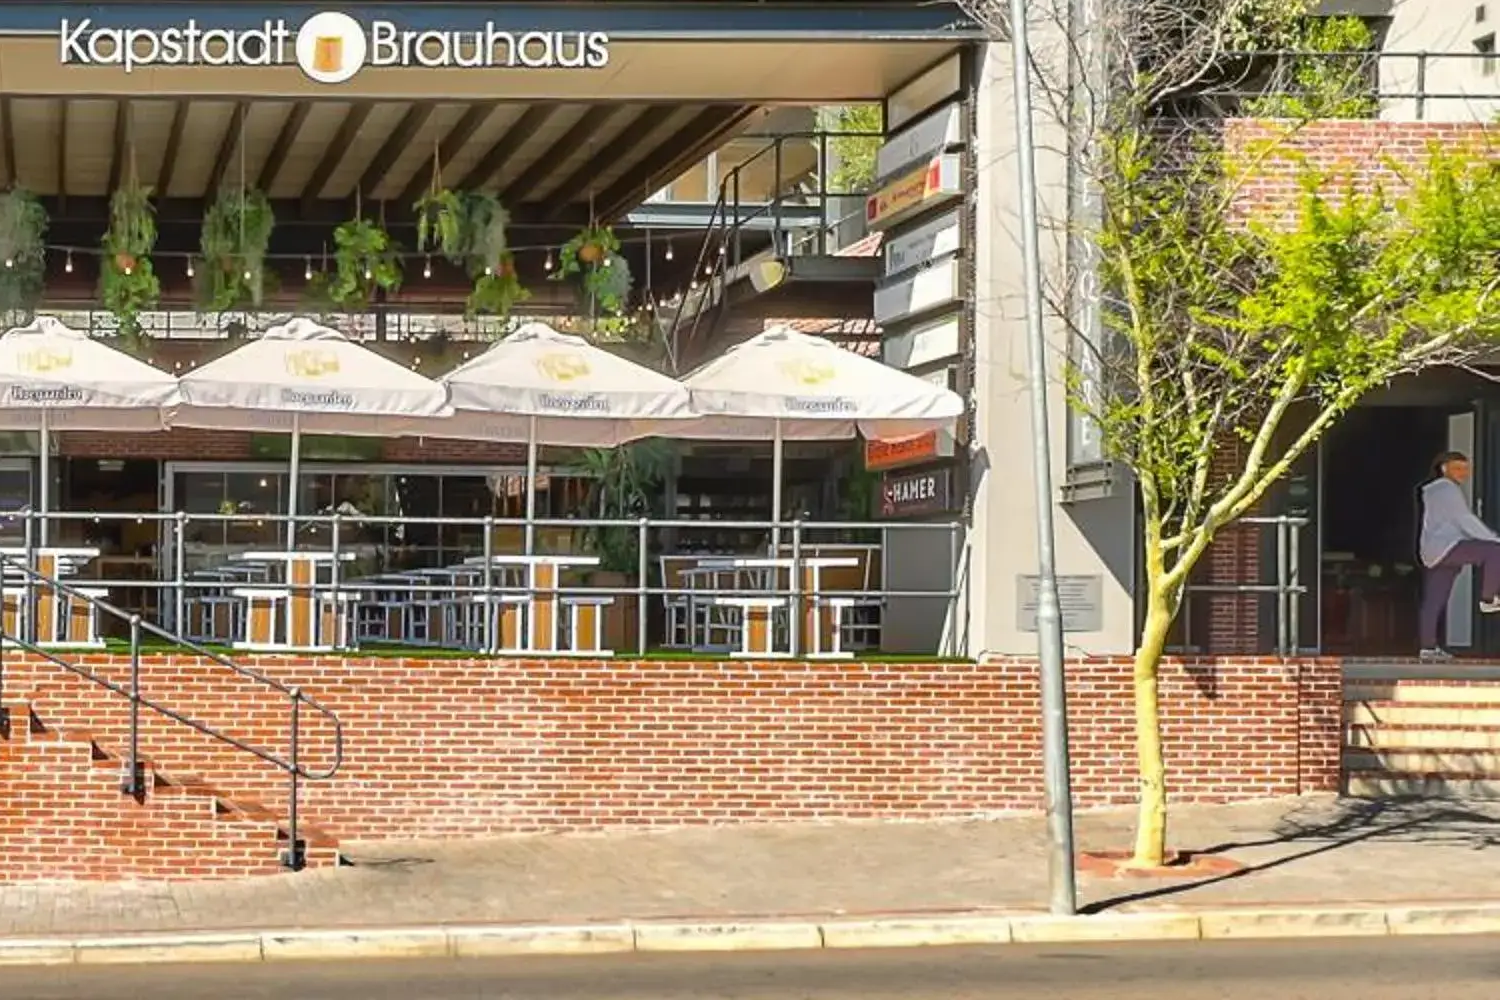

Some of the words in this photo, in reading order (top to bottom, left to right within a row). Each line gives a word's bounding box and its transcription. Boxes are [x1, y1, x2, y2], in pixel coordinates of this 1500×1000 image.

[61, 18, 285, 73] Kapstadt
[372, 21, 609, 67] Brauhaus
[893, 477, 936, 503] HAMER
